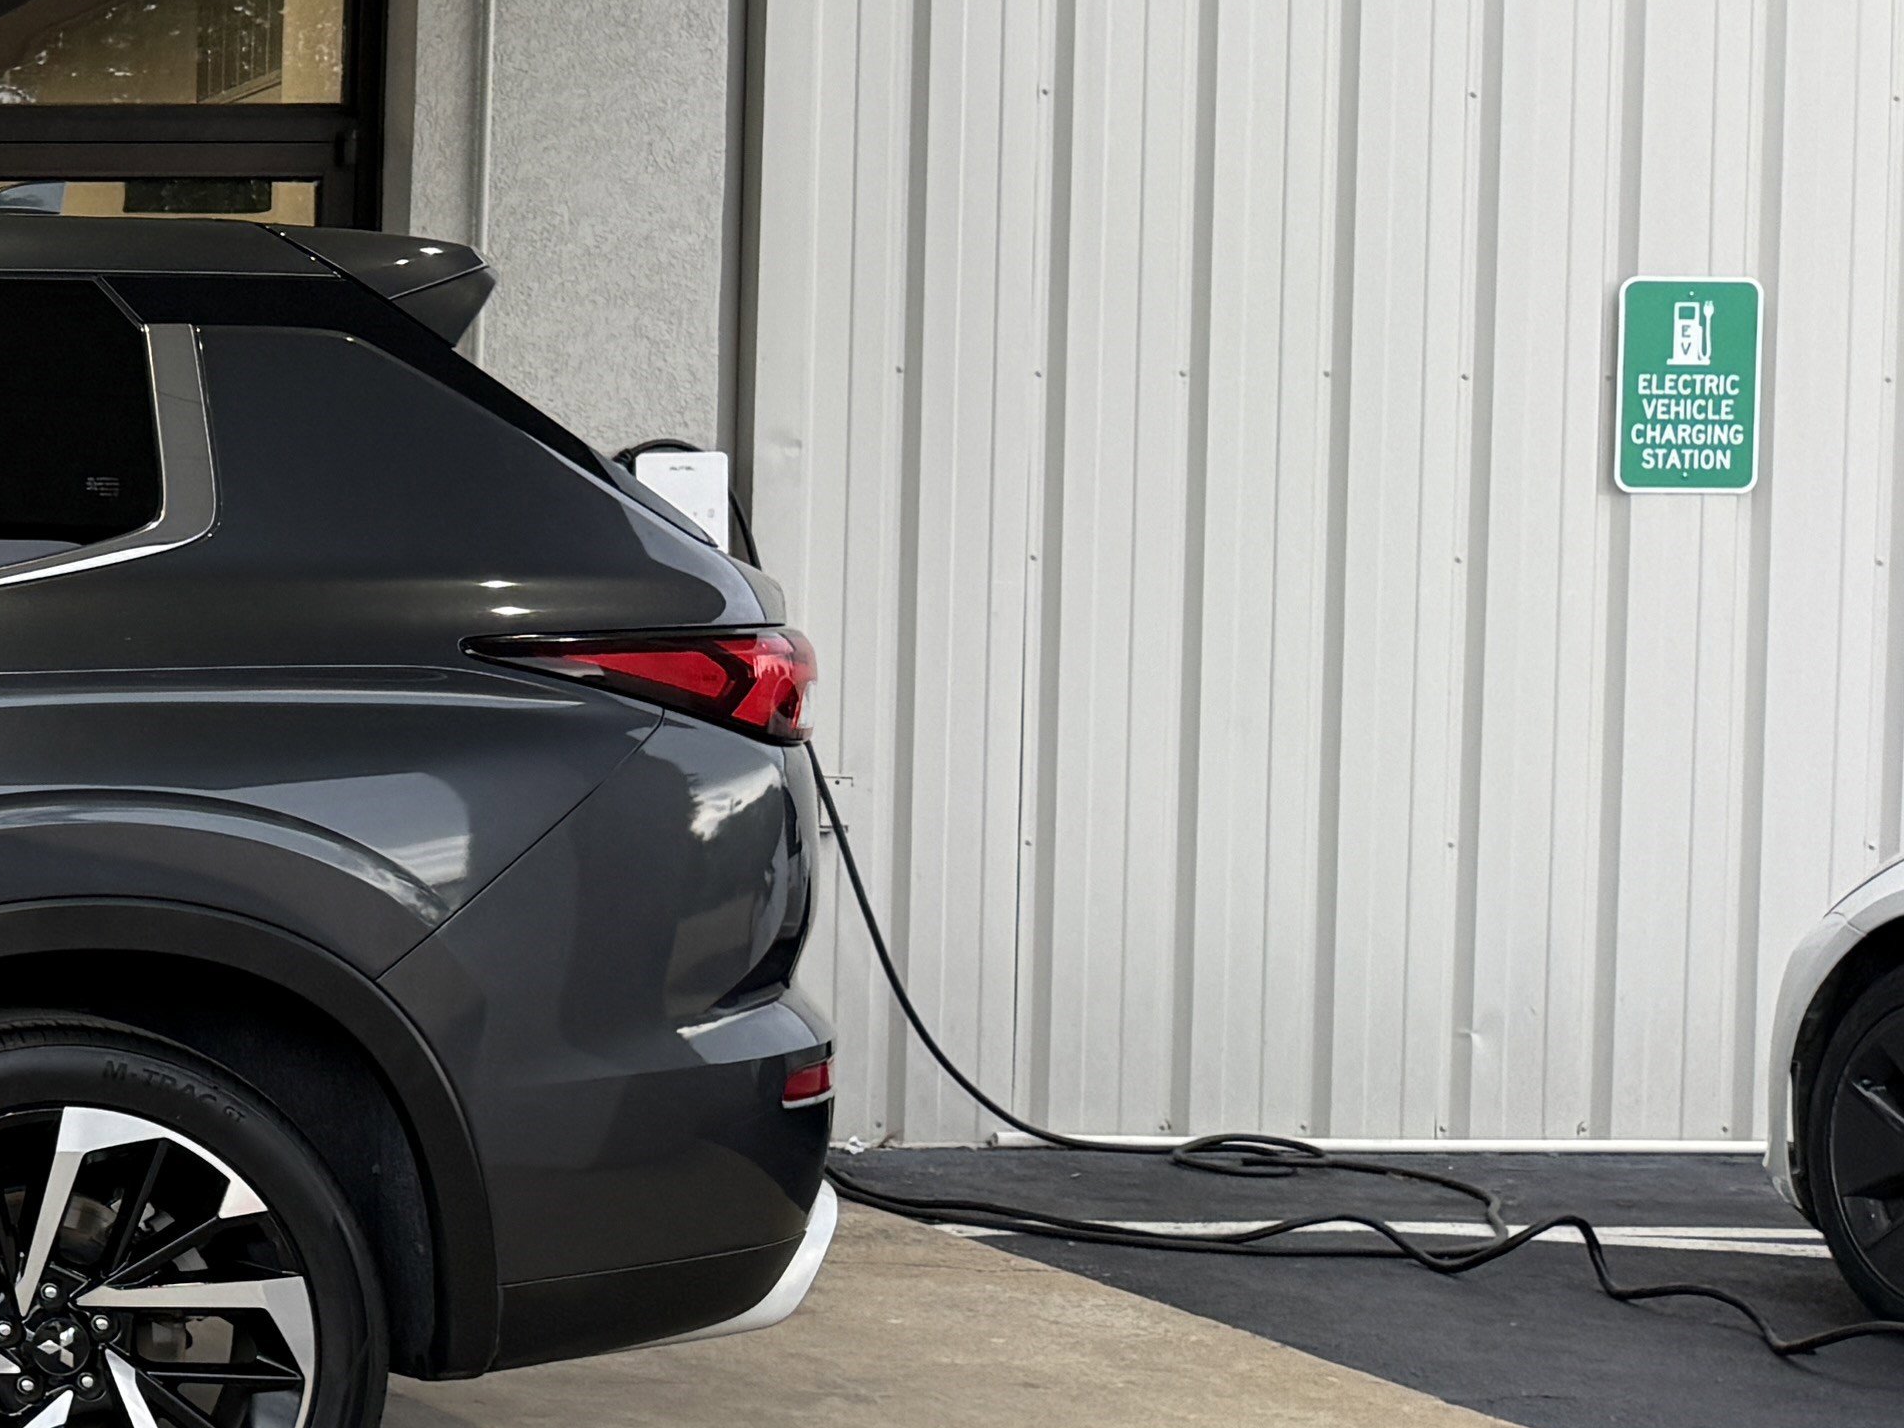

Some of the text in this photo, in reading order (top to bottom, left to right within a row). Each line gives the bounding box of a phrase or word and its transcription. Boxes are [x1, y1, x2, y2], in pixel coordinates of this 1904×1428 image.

[1638, 373, 1740, 396] ELECTRIC
[1642, 398, 1735, 421] VEHICLE
[1630, 423, 1744, 445] CHARGING
[1641, 448, 1732, 470] STATION
